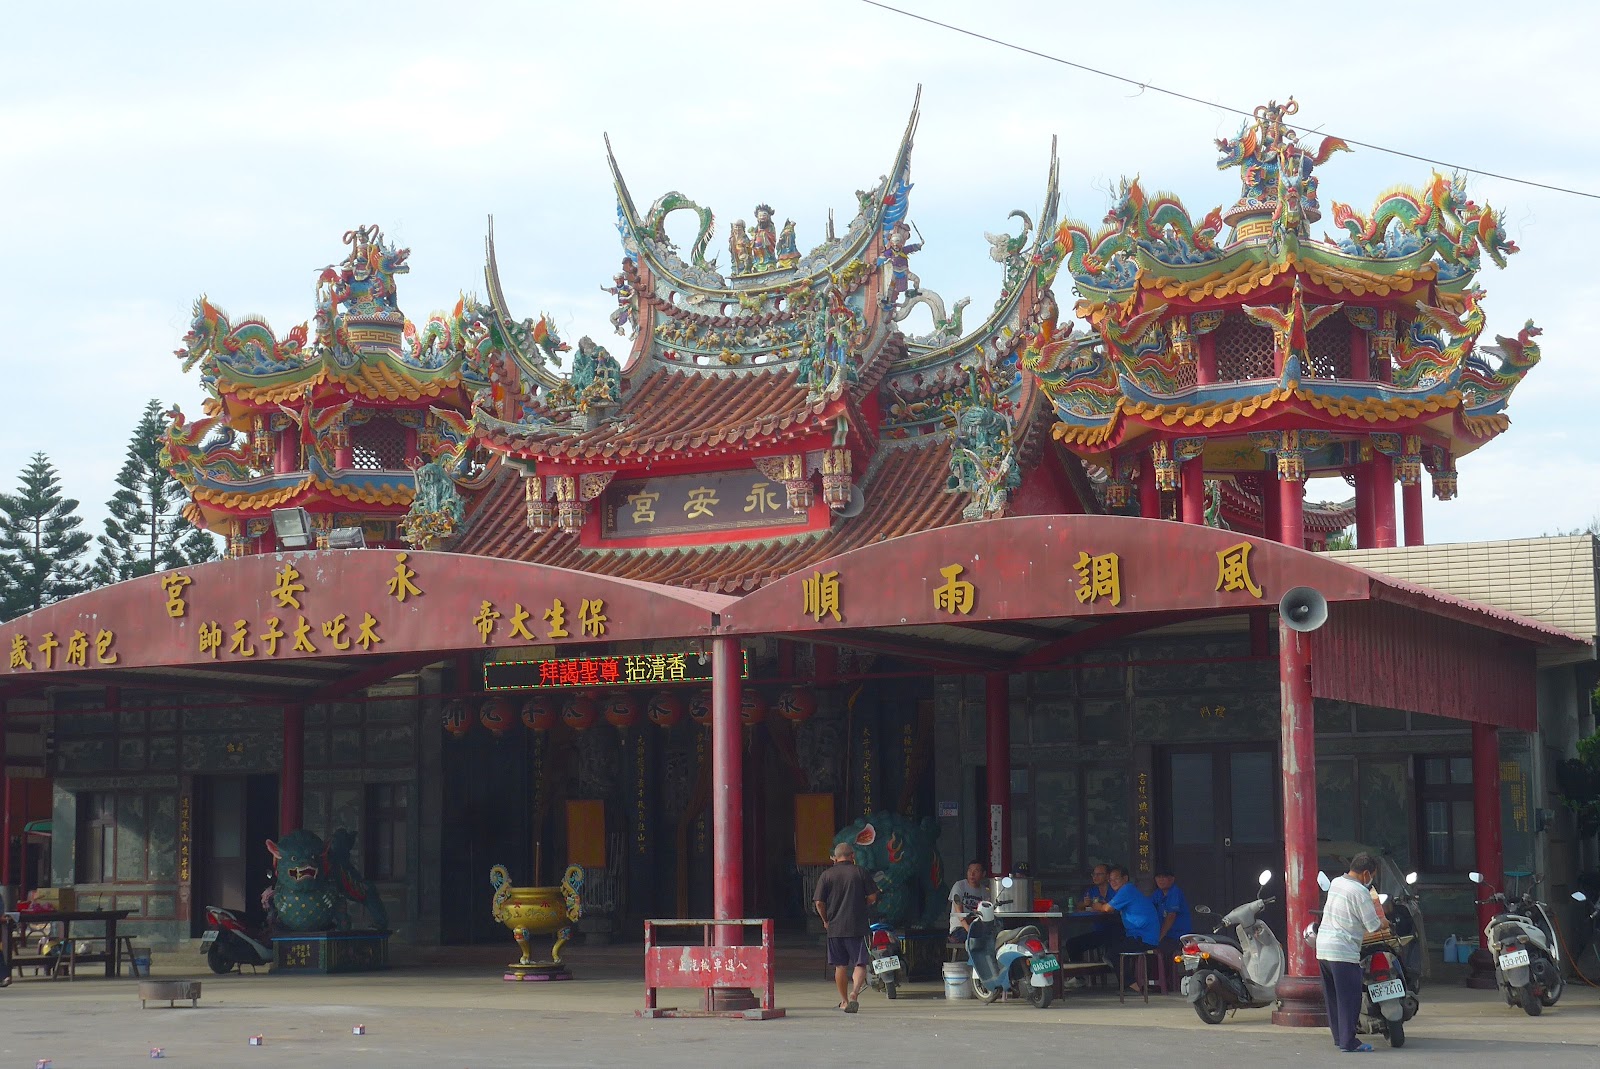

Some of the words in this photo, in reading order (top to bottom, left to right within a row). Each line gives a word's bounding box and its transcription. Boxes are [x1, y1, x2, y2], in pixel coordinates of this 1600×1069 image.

[627, 482, 781, 525] 永安宮
[161, 552, 423, 618] 永安宮
[801, 541, 1264, 624] 風調雨順
[198, 612, 381, 658] 木吒太子元帥
[472, 597, 607, 644] 保生大帝
[9, 629, 118, 671] 包府千歲
[539, 659, 619, 685] 拜謁聖尊
[625, 655, 687, 683] 拈清香
